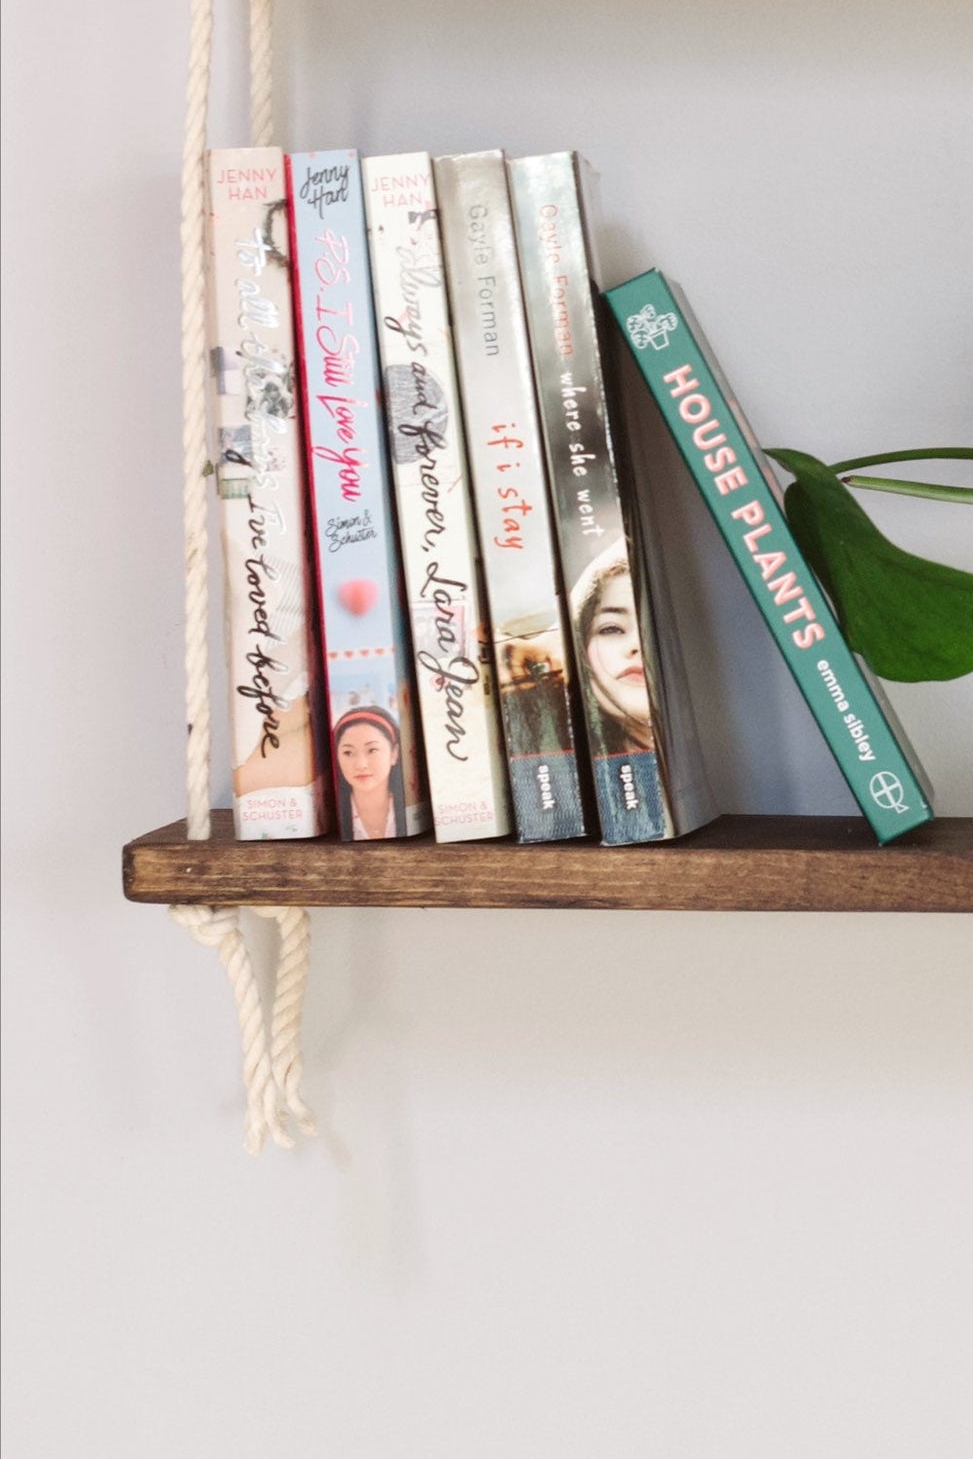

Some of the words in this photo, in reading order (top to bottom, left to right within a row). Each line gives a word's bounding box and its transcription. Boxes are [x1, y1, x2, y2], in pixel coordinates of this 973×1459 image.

[217, 169, 277, 185] JENNY
[228, 188, 268, 201] HAN
[300, 163, 350, 199] Jenny
[372, 174, 430, 193] JENNY
[307, 187, 348, 220] Han
[383, 194, 422, 208] HAN
[469, 204, 488, 266] Gayle
[540, 204, 560, 264] Gayle
[553, 275, 575, 357] Forman
[235, 278, 279, 330] all
[316, 294, 354, 325] I
[478, 275, 500, 357] Forman
[316, 325, 360, 387] Still
[411, 361, 438, 415] and
[560, 371, 586, 431] where
[316, 395, 368, 444] Love
[487, 422, 524, 449] if
[496, 462, 520, 472] i
[569, 443, 596, 477] she
[325, 516, 361, 538] Simon
[494, 488, 533, 549] stay
[577, 489, 605, 537] went
[662, 363, 750, 496] HOUSE
[730, 499, 826, 650] PLANTS
[328, 525, 378, 553] Schuster
[245, 553, 282, 641] loved
[420, 562, 467, 653] Lara
[237, 643, 290, 759] before
[417, 650, 480, 762] Jean
[816, 658, 850, 714] emma
[841, 709, 877, 763] sibley
[247, 799, 286, 810] SIMON
[289, 797, 297, 808] &
[438, 802, 476, 814] SIMON
[480, 800, 489, 811] &
[537, 764, 555, 810] speak
[620, 764, 640, 810] speak
[243, 809, 302, 821] SCHUSTER
[435, 811, 494, 826] SCHUSTER
